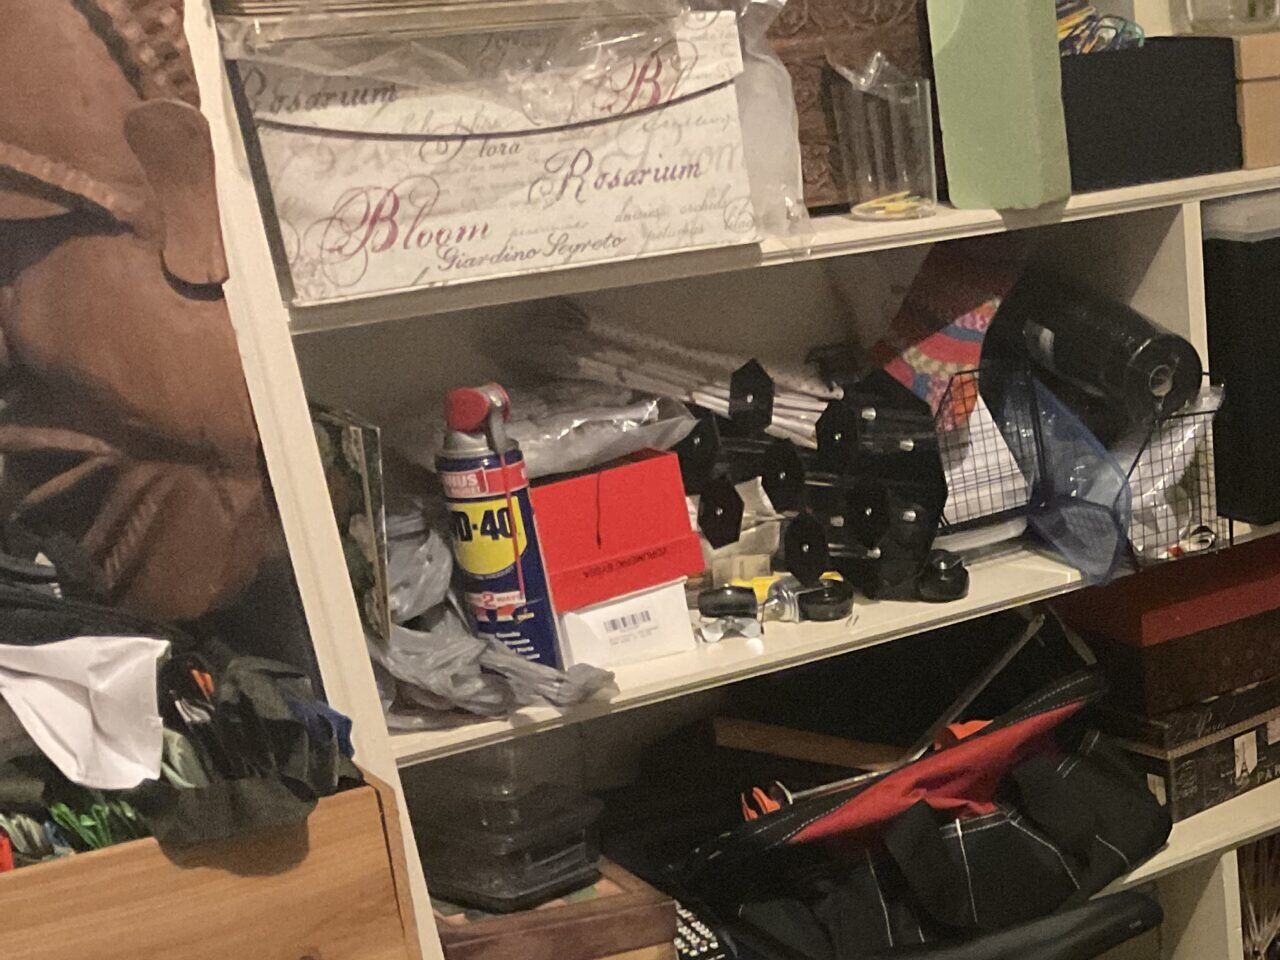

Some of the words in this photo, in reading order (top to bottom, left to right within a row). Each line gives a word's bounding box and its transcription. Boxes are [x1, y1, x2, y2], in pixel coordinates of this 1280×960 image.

[528, 147, 702, 206] Rosarium
[304, 175, 489, 286] Bloom
[437, 242, 541, 272] Giardino
